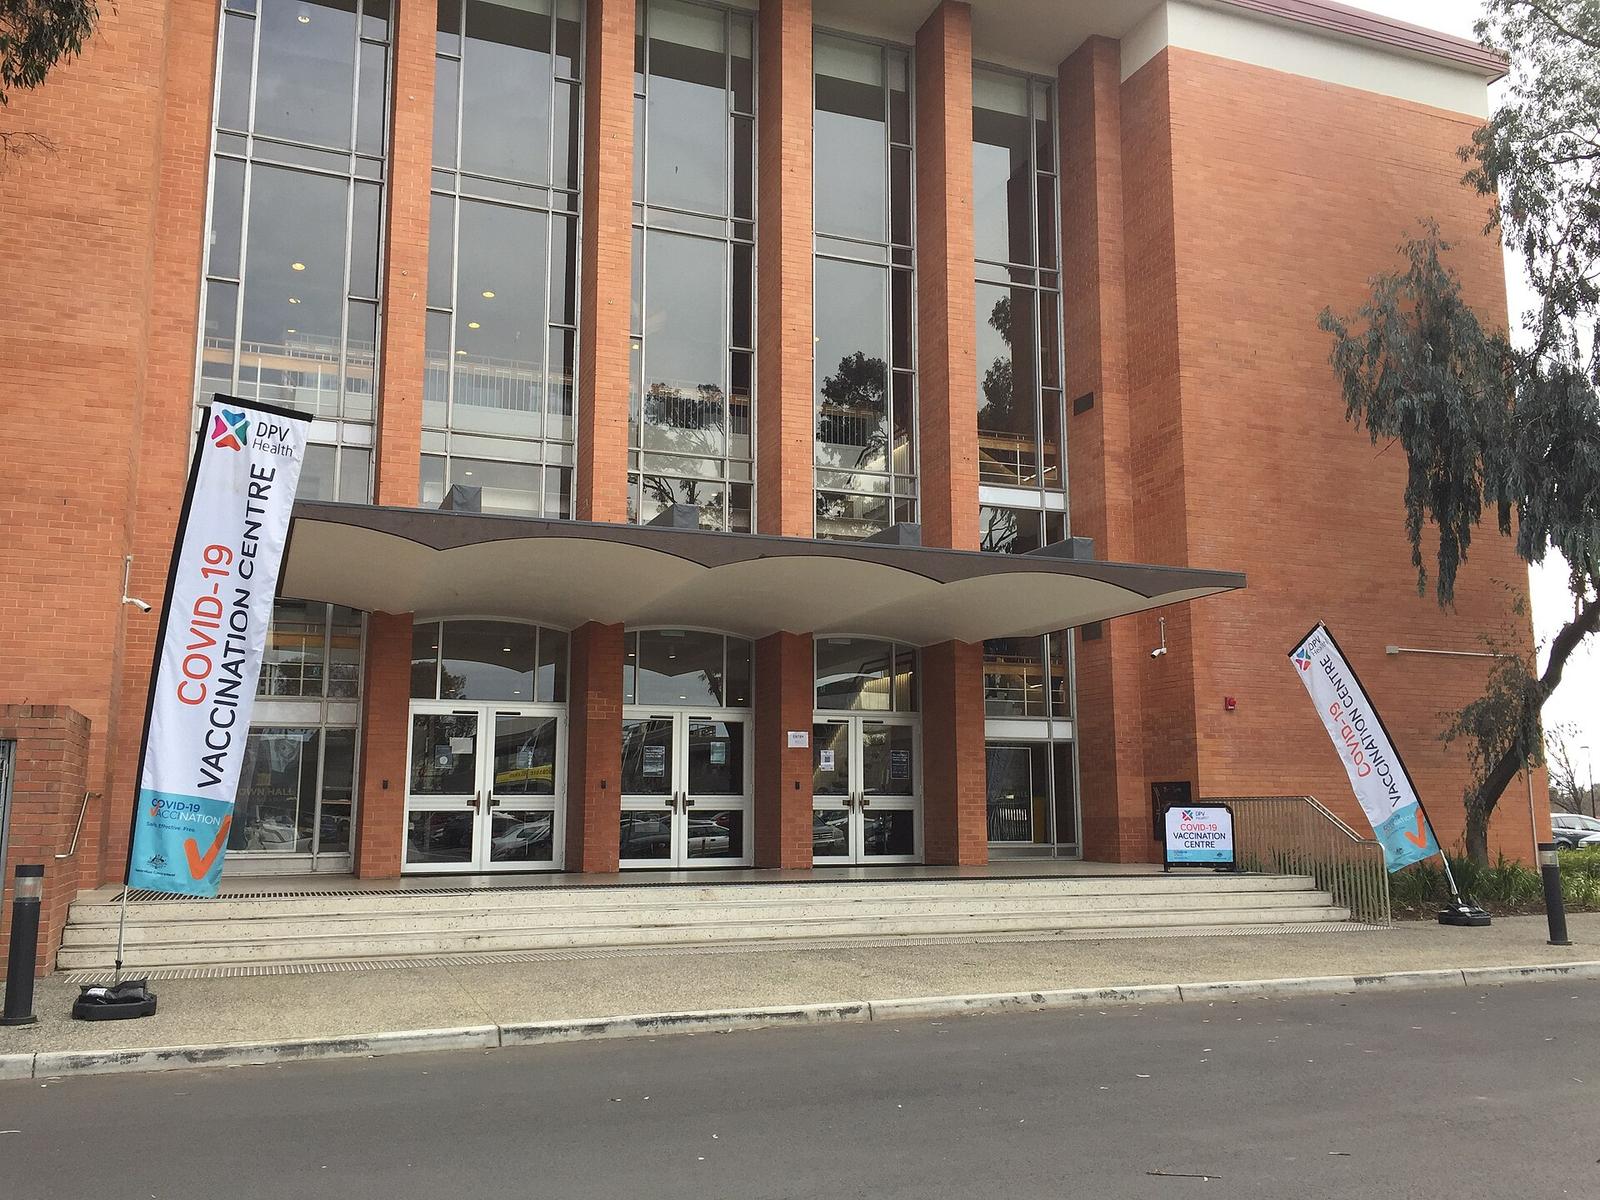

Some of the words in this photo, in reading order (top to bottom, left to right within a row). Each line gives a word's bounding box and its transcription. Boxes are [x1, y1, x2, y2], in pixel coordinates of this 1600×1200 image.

[256, 421, 290, 442] DPV
[177, 544, 233, 705] COVID-19
[197, 588, 251, 788] VACCINATION
[238, 463, 276, 580] CENTRE
[1319, 654, 1354, 709] CENTRE
[1329, 702, 1372, 777] COVID-19
[1348, 707, 1402, 808] VACCINATION
[152, 798, 200, 813] COVID-19
[1173, 832, 1226, 840] VACCINATION
[1180, 823, 1218, 831] COVID-19
[1184, 840, 1216, 848] CENTRE
